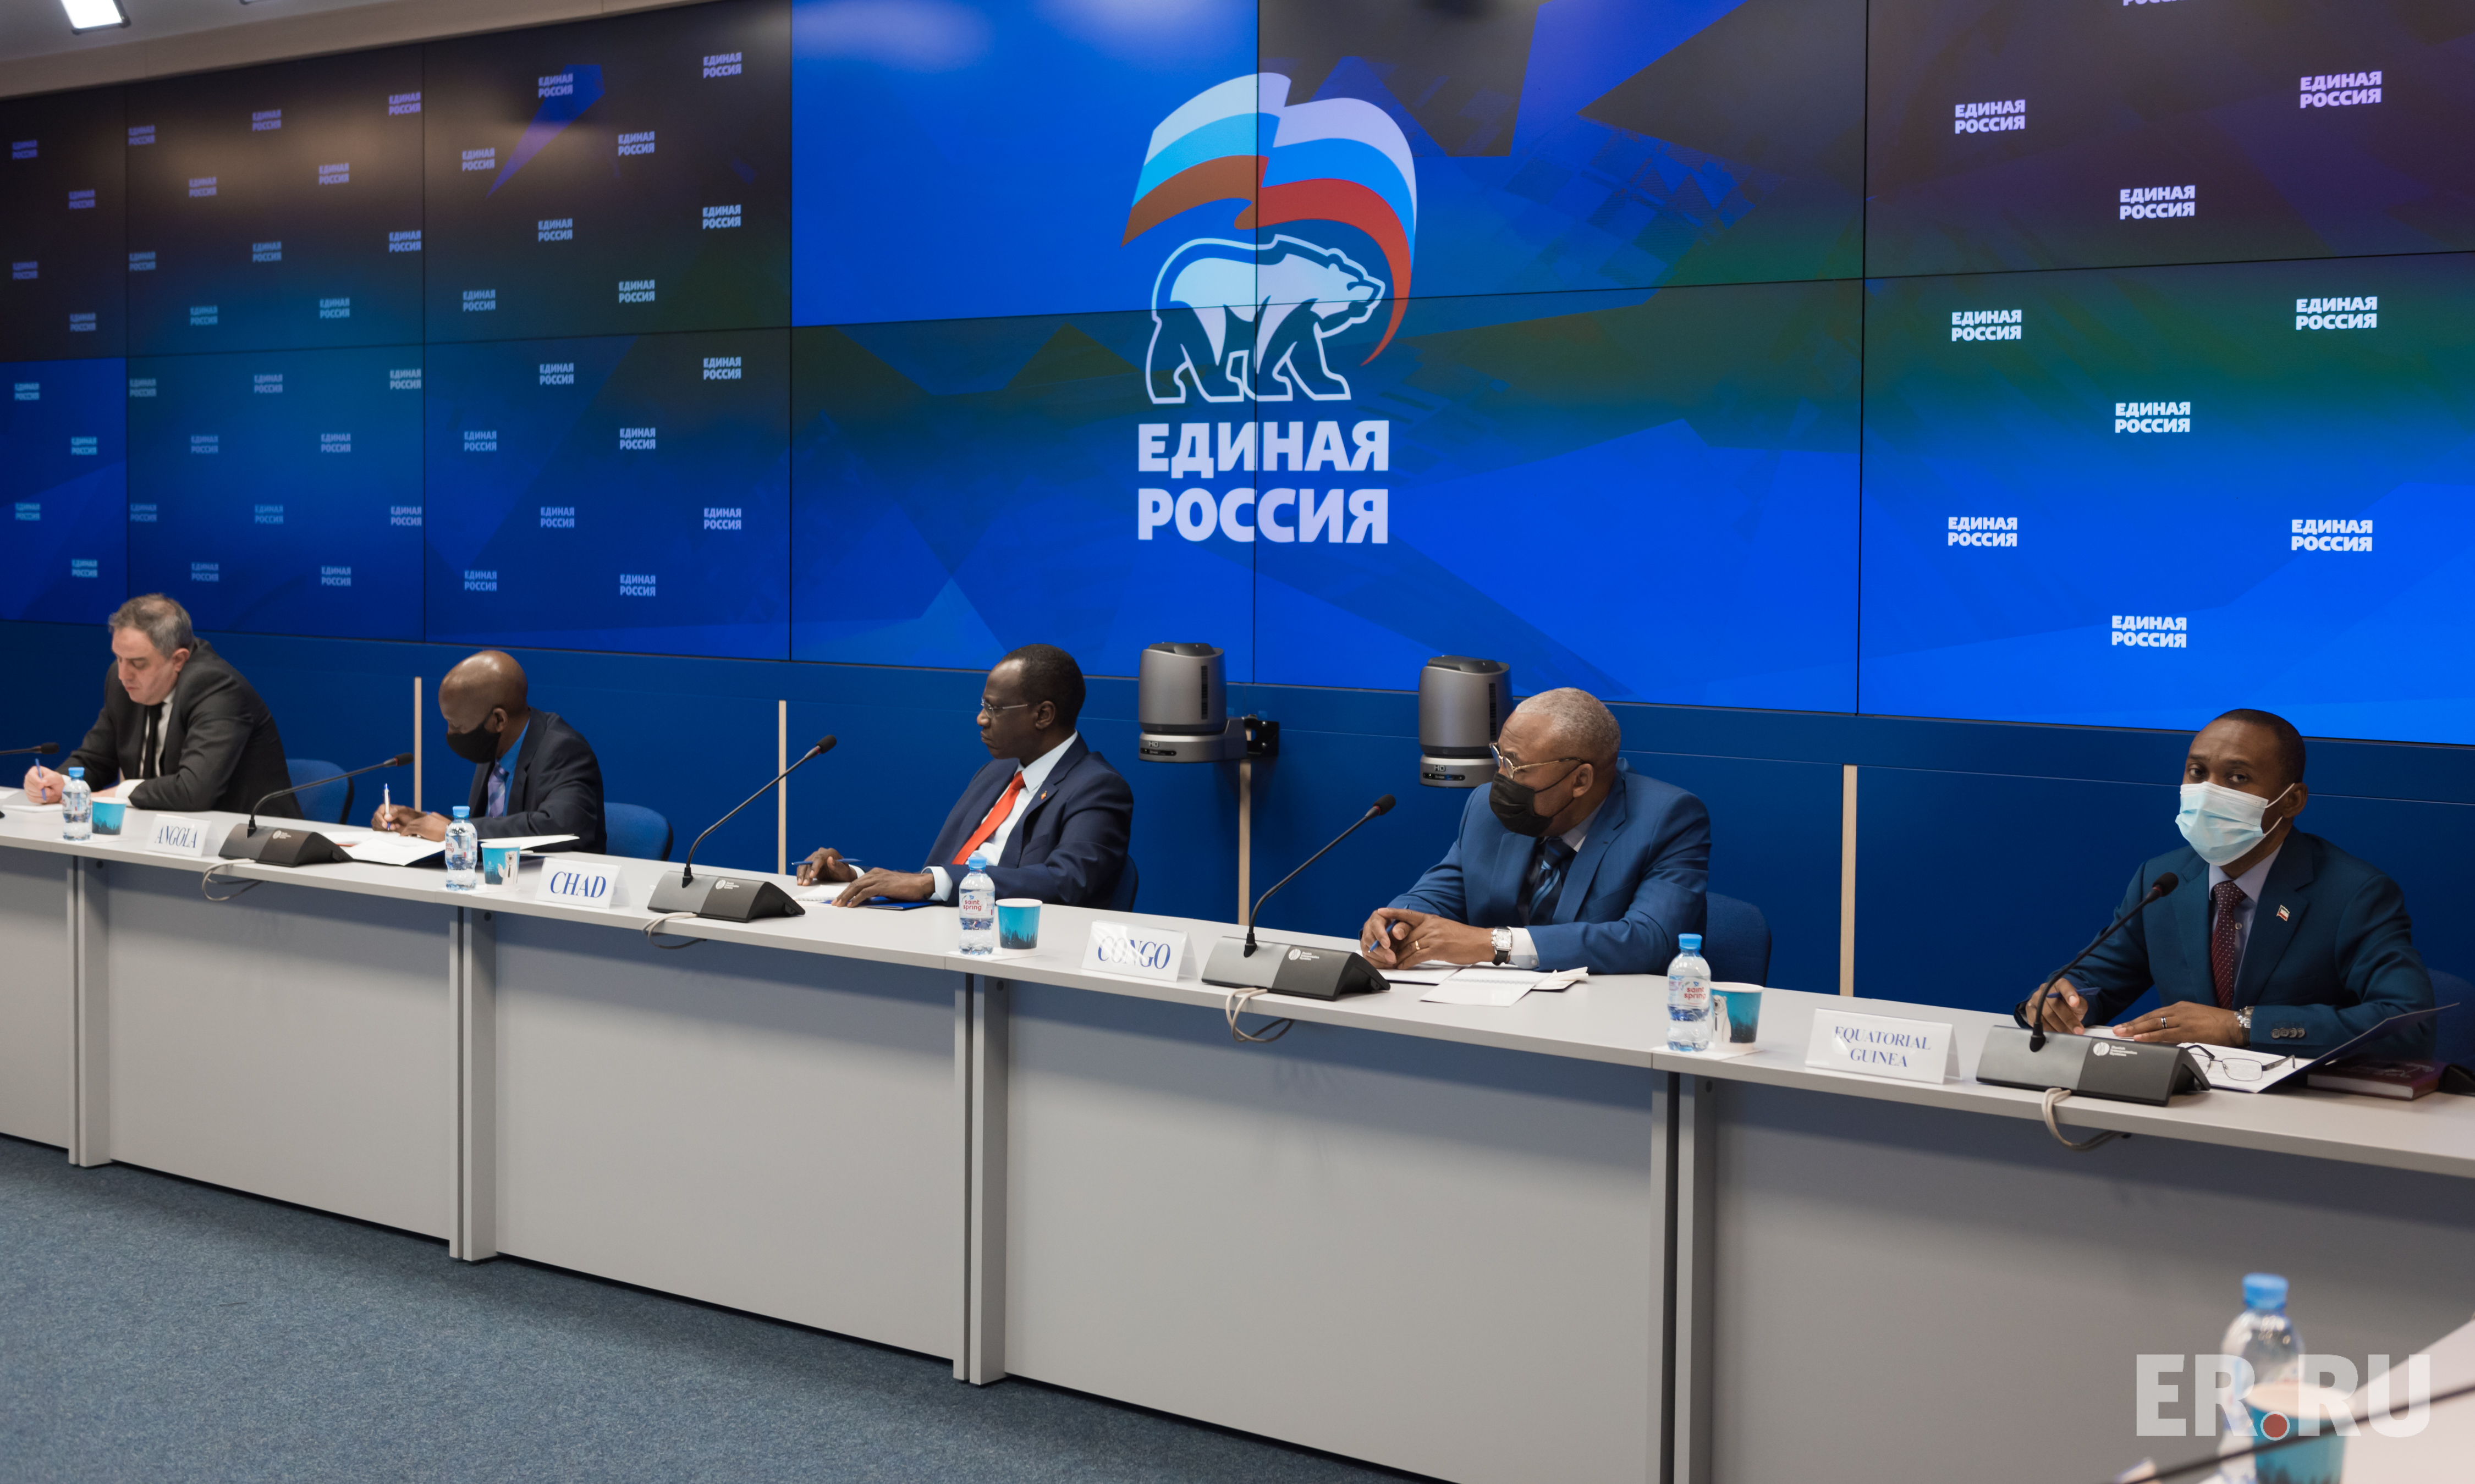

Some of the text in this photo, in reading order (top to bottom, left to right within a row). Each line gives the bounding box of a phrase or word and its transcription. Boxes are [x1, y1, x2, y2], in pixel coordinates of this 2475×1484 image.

[703, 52, 741, 67] ЕДИНАЯ
[703, 64, 741, 78] РОССИЯ
[538, 74, 573, 87] ЕДИНАЯ
[2301, 71, 2382, 92] ЕДИНАЯ
[538, 85, 573, 97] РОССИЯ
[2300, 88, 2382, 108] РОССИЯ
[1955, 100, 2025, 118] ЕДИНАЯ
[1955, 115, 2025, 134] РОССИЯ
[618, 131, 654, 145] ЕДИНАЯ
[462, 148, 494, 161] ЕДИНАЯ
[618, 142, 654, 156] РОССИЯ
[462, 159, 494, 171] РОССИЯ
[2120, 185, 2195, 203] ЕДИНАЯ
[703, 205, 741, 218] ЕДИНАЯ
[2120, 202, 2195, 219] РОССИЯ
[538, 218, 573, 231] ЕДИНАЯ
[703, 216, 741, 229] РОССИЯ
[538, 229, 573, 241] РОССИЯ
[619, 280, 654, 292] ЕДИНАЯ
[463, 290, 496, 301] ЕДИНАЯ
[619, 291, 654, 303] РОССИЯ
[463, 300, 496, 311] РОССИЯ
[2296, 296, 2377, 314] ЕДИНАЯ
[1952, 310, 2022, 326] ЕДИНАЯ
[2296, 313, 2377, 330] РОССИЯ
[1952, 326, 2021, 341] РОССИЯ
[540, 363, 574, 374] ЕДИНАЯ
[703, 357, 741, 368] ЕДИНАЯ
[540, 374, 574, 385] РОССИЯ
[703, 368, 741, 379] РОССИЯ
[2115, 402, 2190, 417] ЕДИНАЯ
[2115, 418, 2190, 433] РОССИЯ
[464, 431, 497, 440] ЕДИНАЯ
[620, 428, 656, 439] ЕДИНАЯ
[464, 442, 497, 451] РОССИЯ
[620, 439, 656, 449] РОССИЯ
[1138, 420, 1389, 478] ЕДИНАЯ
[541, 507, 574, 517] ЕДИНАЯ
[704, 508, 741, 518] ЕДИНАЯ
[1138, 488, 1388, 543] РОССИЯ
[541, 518, 574, 527] РОССИЯ
[704, 520, 741, 529] РОССИЯ
[1949, 517, 2017, 531] ЕДИНАЯ
[2292, 520, 2373, 534] ЕДИНАЯ
[1948, 532, 2017, 547] РОССИЯ
[2291, 536, 2372, 551] РОССИЯ
[465, 571, 497, 580] ЕДИНАЯ
[620, 575, 656, 585] ЕДИНАЯ
[465, 581, 497, 591] РОССИЯ
[620, 586, 656, 596] РОССИЯ
[2112, 616, 2187, 631] ЕДИНАЯ
[2112, 631, 2186, 648] РОССИЯ
[155, 825, 197, 848] ANGOLA
[551, 871, 606, 898] CHAD
[1098, 936, 1170, 969] CONGO
[1834, 1026, 1931, 1050] EQUATORIAL
[1850, 1048, 1907, 1067] GUINEA
